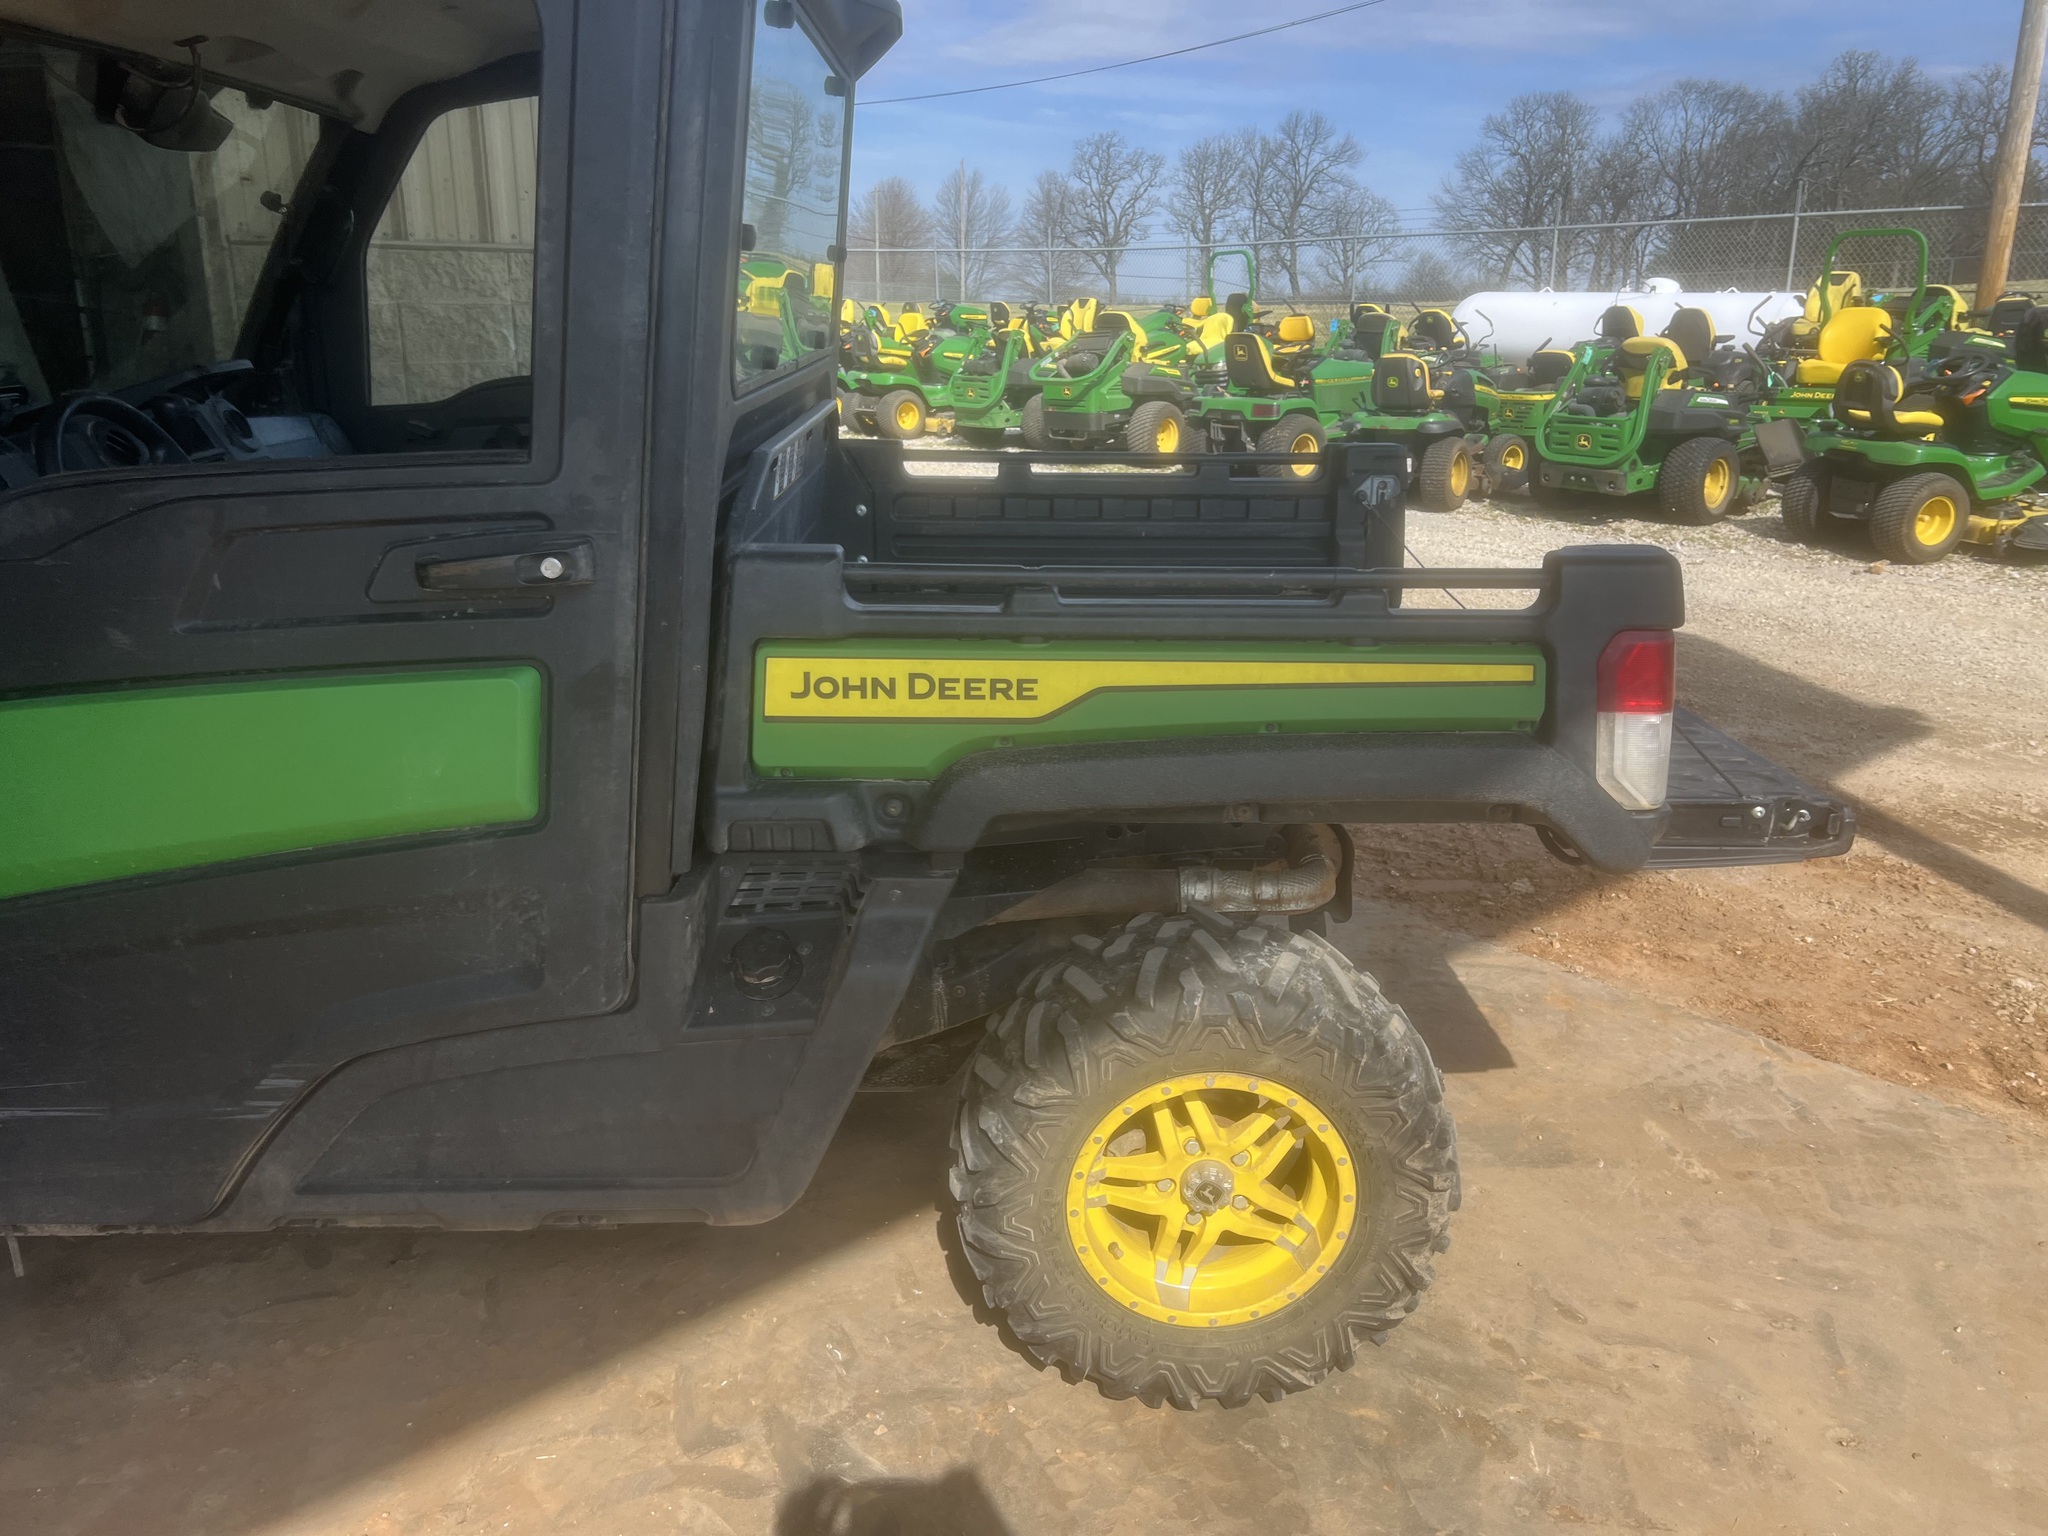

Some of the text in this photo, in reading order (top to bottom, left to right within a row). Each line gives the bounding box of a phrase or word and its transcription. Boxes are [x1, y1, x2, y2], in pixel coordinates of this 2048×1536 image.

[1790, 391, 1813, 399] JOHN
[790, 671, 1038, 701] JOHN DEERE
